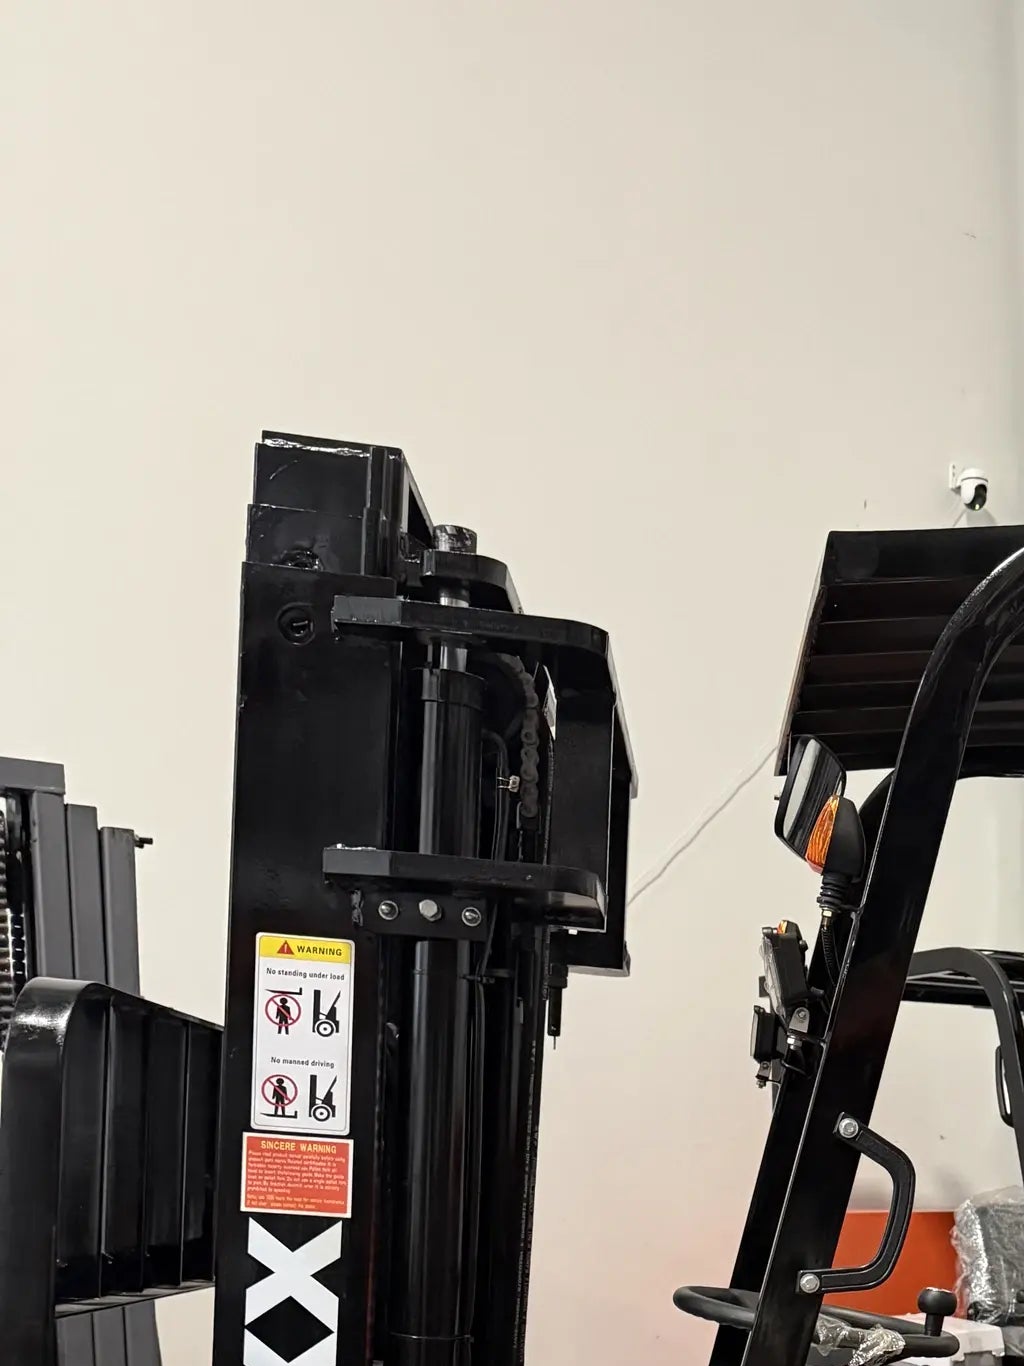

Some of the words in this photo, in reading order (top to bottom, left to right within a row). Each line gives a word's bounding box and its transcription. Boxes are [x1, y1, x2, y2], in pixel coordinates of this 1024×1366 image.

[296, 945, 342, 957] WARNING
[266, 967, 276, 975] No
[278, 969, 307, 979] standing
[309, 971, 328, 979] under
[270, 1056, 281, 1064] No
[282, 1058, 310, 1066] manned
[310, 1059, 335, 1070] driving
[260, 1140, 296, 1151] SINCERE
[299, 1143, 337, 1154] WARNING
